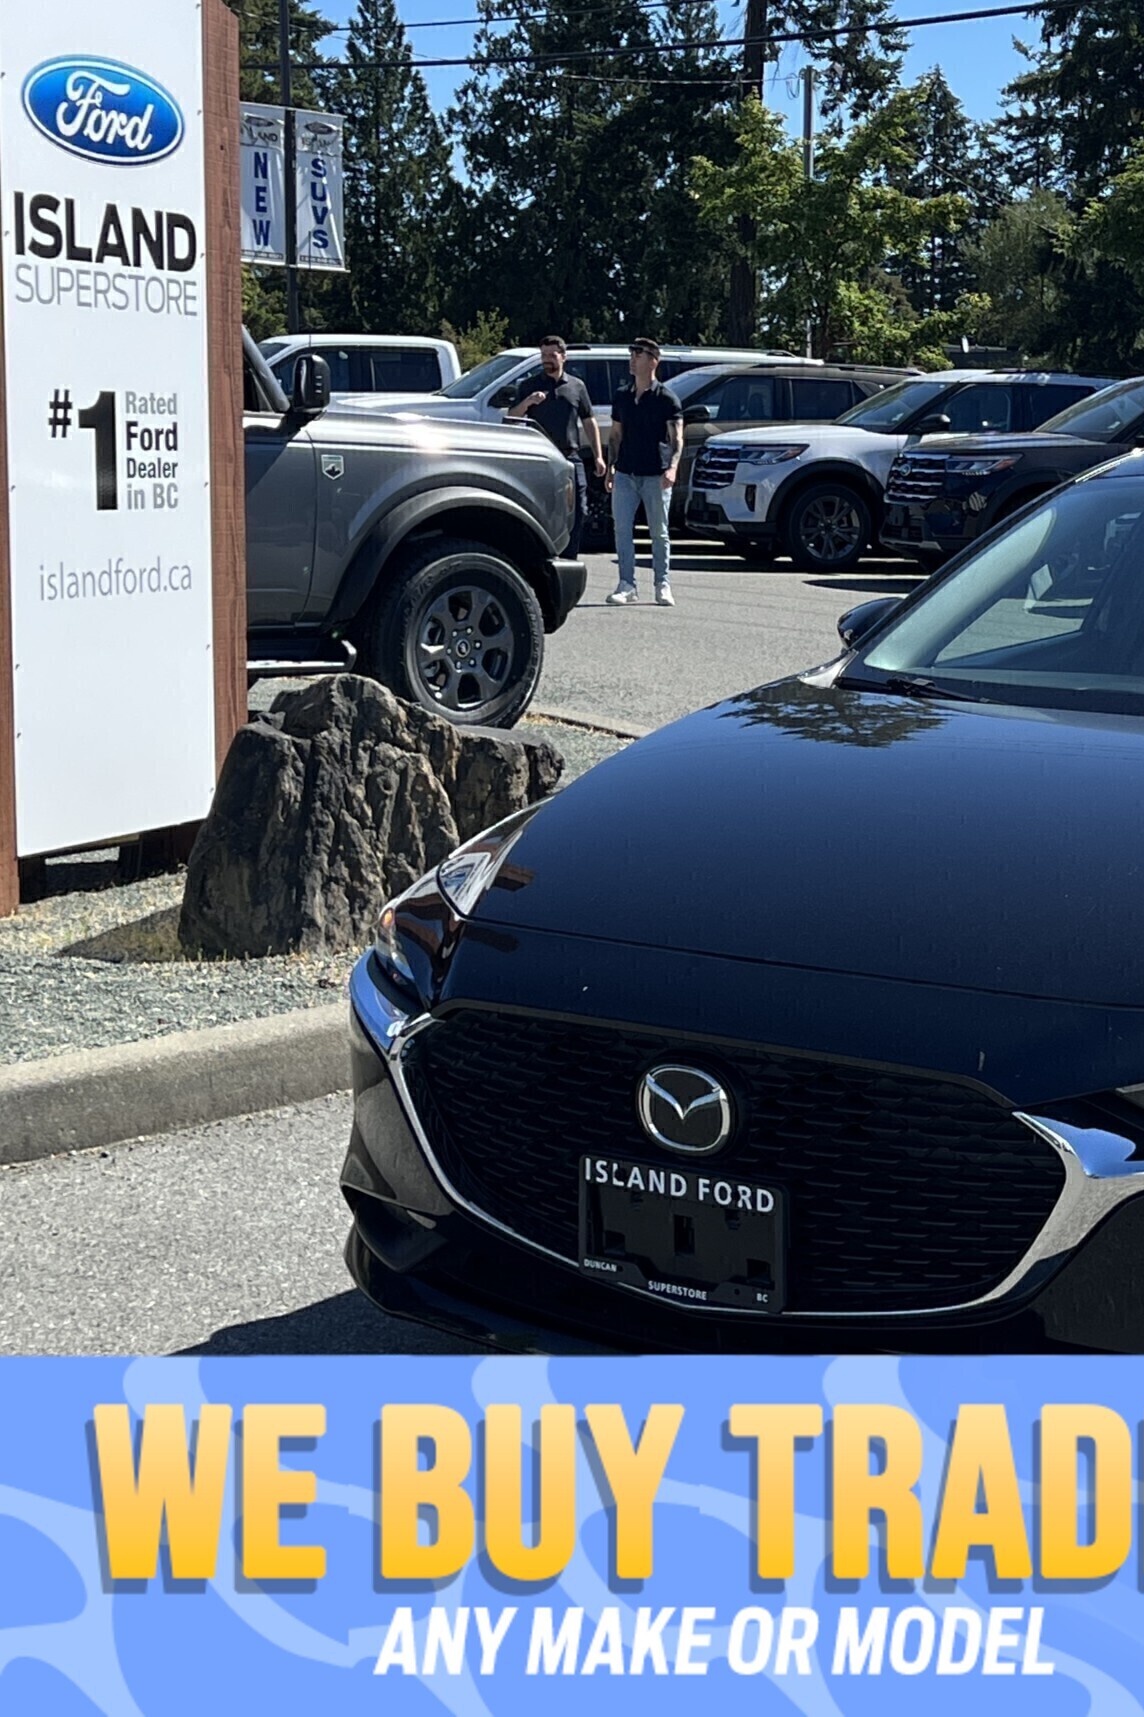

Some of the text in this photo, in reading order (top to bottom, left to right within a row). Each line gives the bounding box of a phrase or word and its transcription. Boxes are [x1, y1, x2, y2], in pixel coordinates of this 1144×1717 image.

[56, 70, 155, 150] Ford
[252, 151, 271, 247] NEW
[310, 157, 329, 249] SUVS
[13, 190, 198, 273] ISLAND
[15, 263, 198, 317] SUPERSTORE
[125, 391, 178, 415] Rated
[47, 388, 118, 511] #1
[125, 420, 178, 452] Ford
[126, 457, 178, 479] Dealer
[127, 482, 179, 510] in BC
[40, 555, 192, 601] islandford.ca
[584, 1157, 775, 1213] ISLAND FORD
[583, 1258, 617, 1273] DUNCAN
[648, 1280, 708, 1301] SUPERSTORE
[756, 1292, 769, 1303] BC
